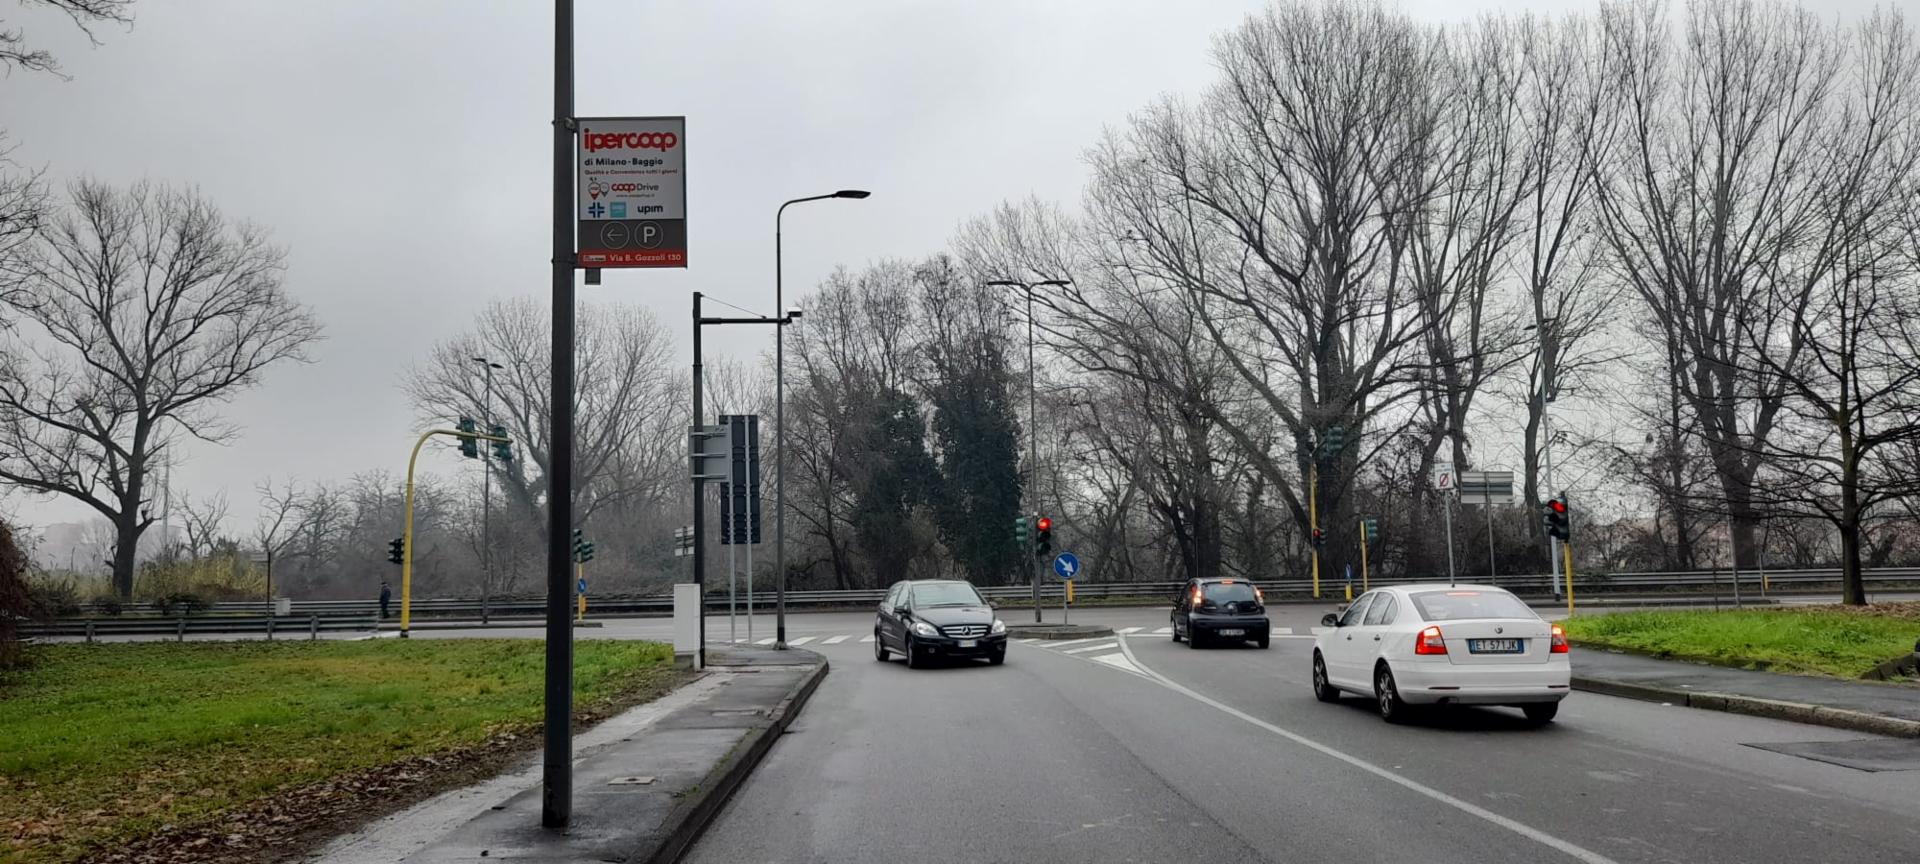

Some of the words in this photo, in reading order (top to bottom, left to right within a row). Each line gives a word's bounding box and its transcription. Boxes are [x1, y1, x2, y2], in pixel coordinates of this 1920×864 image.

[584, 128, 677, 153] ipercoop
[584, 157, 593, 166] di
[611, 183, 636, 192] coop
[637, 183, 659, 191] Drive
[637, 205, 663, 215] upim
[643, 226, 656, 243] P
[610, 254, 623, 262] Via
[625, 254, 632, 262] B.
[635, 254, 665, 262] Gozzoli
